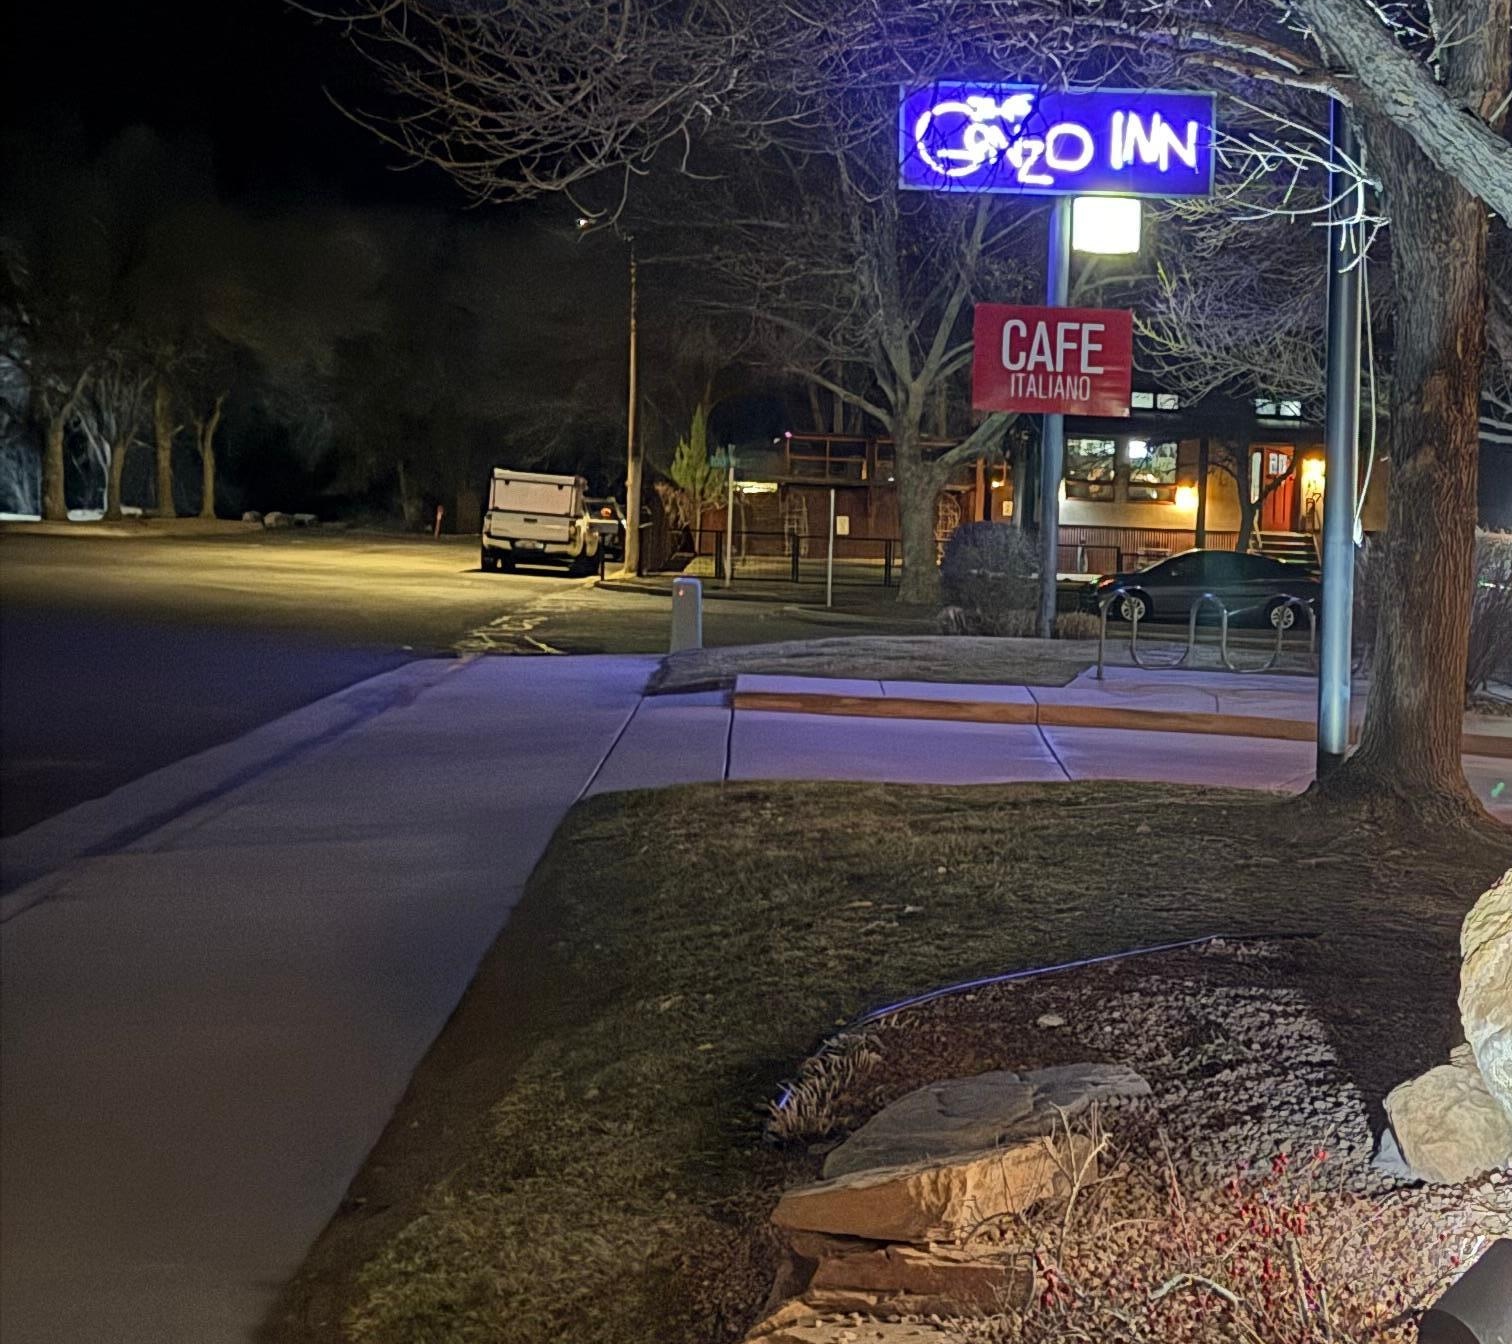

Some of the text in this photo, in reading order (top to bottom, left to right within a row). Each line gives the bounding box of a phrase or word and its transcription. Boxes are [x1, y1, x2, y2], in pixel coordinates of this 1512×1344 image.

[1110, 111, 1199, 171] INN
[1001, 318, 1105, 375] CAFE
[1009, 372, 1091, 401] ITALIANO
